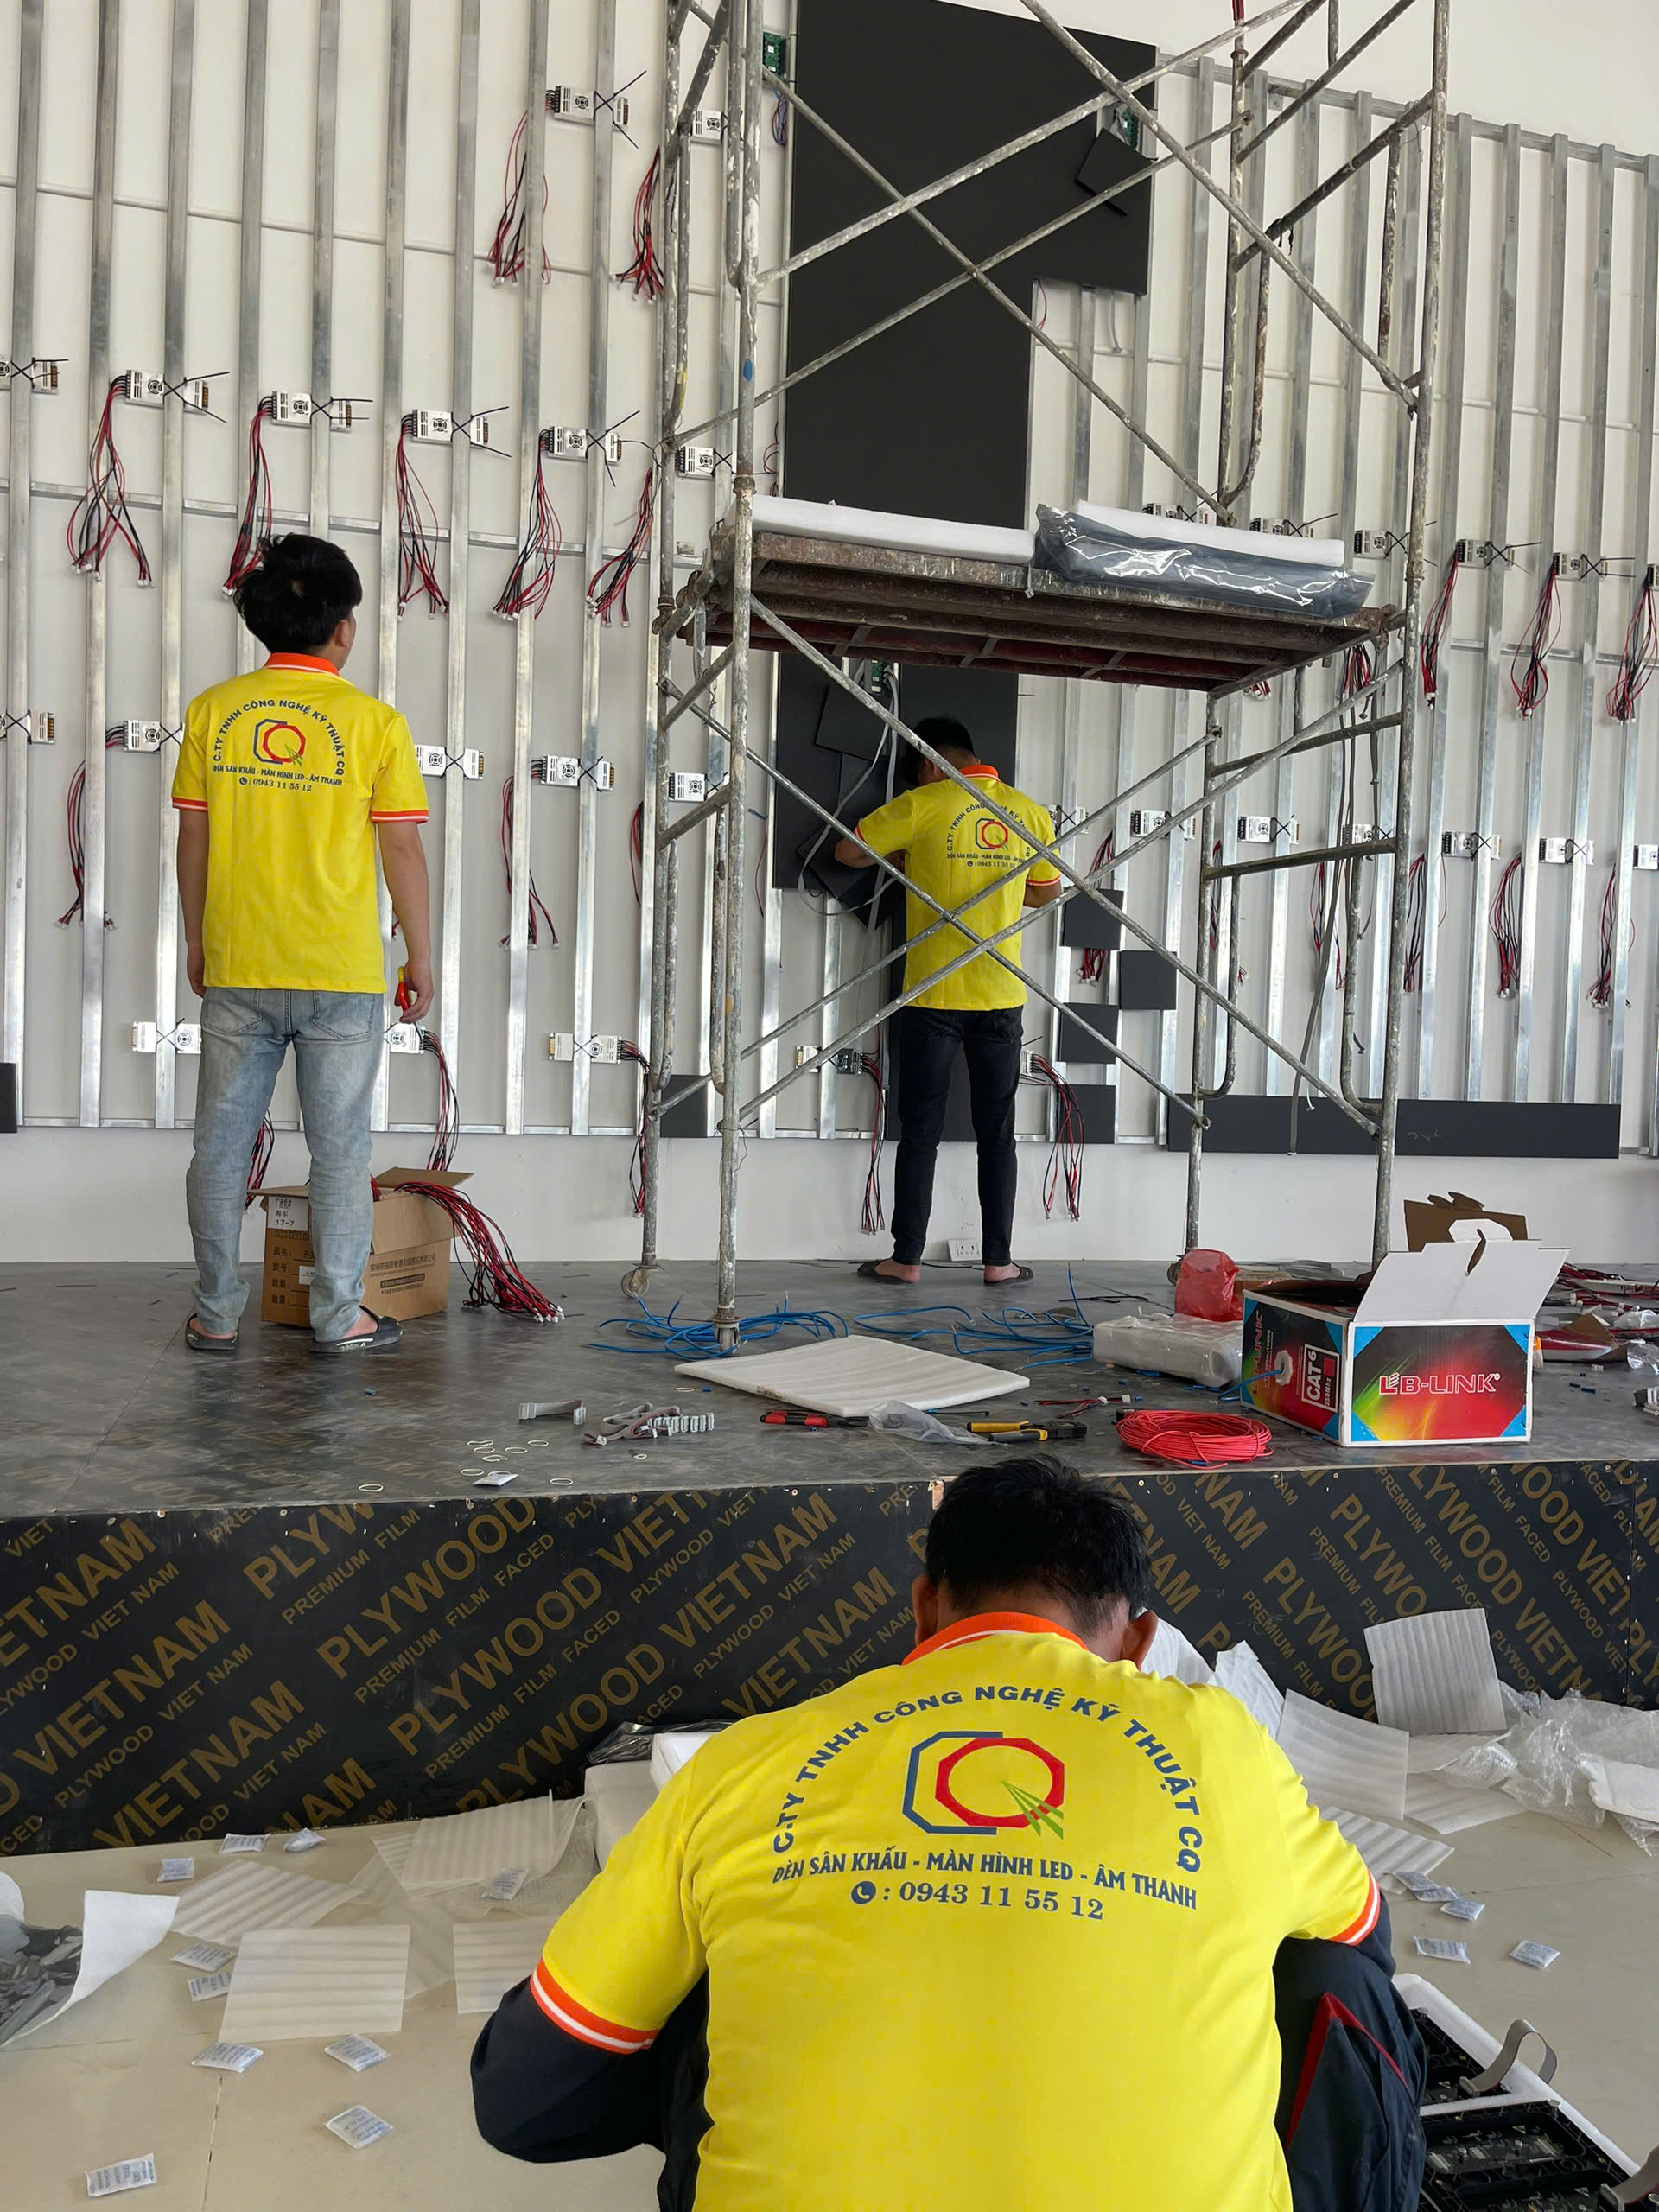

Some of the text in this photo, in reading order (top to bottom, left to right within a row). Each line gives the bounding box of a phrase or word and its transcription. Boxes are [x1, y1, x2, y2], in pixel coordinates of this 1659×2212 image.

[219, 709, 243, 735] TNHH
[243, 699, 276, 712] CÔNG
[253, 779, 274, 787] 0943
[4, 1519, 54, 1557] VIET
[282, 1508, 421, 1625] PREMIUM FILM
[658, 1492, 837, 1648] VIETNAM
[1177, 1497, 1231, 1570] VIET NAM
[1309, 1527, 1362, 1595] PREMIUM
[1376, 1467, 1426, 1534] PREMIUM
[1425, 1535, 1453, 1572] FILM
[1488, 1476, 1516, 1512] FILM
[1514, 1515, 1550, 1562] FACED
[1553, 1570, 1603, 1638] PLYWOOD
[81, 1599, 130, 1640] VIET
[131, 1562, 180, 1604] NAM
[316, 1498, 535, 1679] PLYWOOD
[353, 1628, 442, 1703] PREMIUM
[444, 1586, 490, 1627] FILM
[493, 1534, 554, 1586] FACED
[424, 1490, 757, 1780] PREMIUM FILM FACED PLYWOOD VIET
[692, 1604, 775, 1679] PLYWOOD
[778, 1564, 818, 1602] VIET
[816, 1532, 856, 1569] NAM
[721, 1566, 897, 1718] VIETNAM
[837, 1605, 914, 1676] VIET NAM
[1243, 1590, 1324, 1696] PREMIUM FILM
[1262, 1556, 1378, 1723] PLYWOO
[13, 1600, 231, 1775] VIETNAM
[55, 1725, 154, 1808] PLYWOOD
[157, 1680, 205, 1721] VIET
[207, 1643, 253, 1684] NAM
[389, 1568, 601, 1756] PLYWOOD
[92, 1680, 305, 1847] VIETNAM
[233, 1759, 279, 1800] VIET
[281, 1722, 327, 1764] NAM
[773, 1686, 1203, 1872] C.TY TNHH CÔNG NGHỆ KỸ THUẬT CQ
[810, 1851, 846, 1875] SÂN
[851, 1846, 907, 1872] KHẤU
[926, 1849, 973, 1872] MÀN
[980, 1851, 1033, 1876] HÌNH
[1039, 1859, 1073, 1880] LED
[1094, 1864, 1125, 1890] ÂM
[1132, 1873, 1197, 1910] THANH
[899, 1882, 968, 1904] 0943
[980, 1885, 1012, 1907] 11
[1024, 1889, 1058, 1911] 55
[1071, 1896, 1103, 1920] 12
